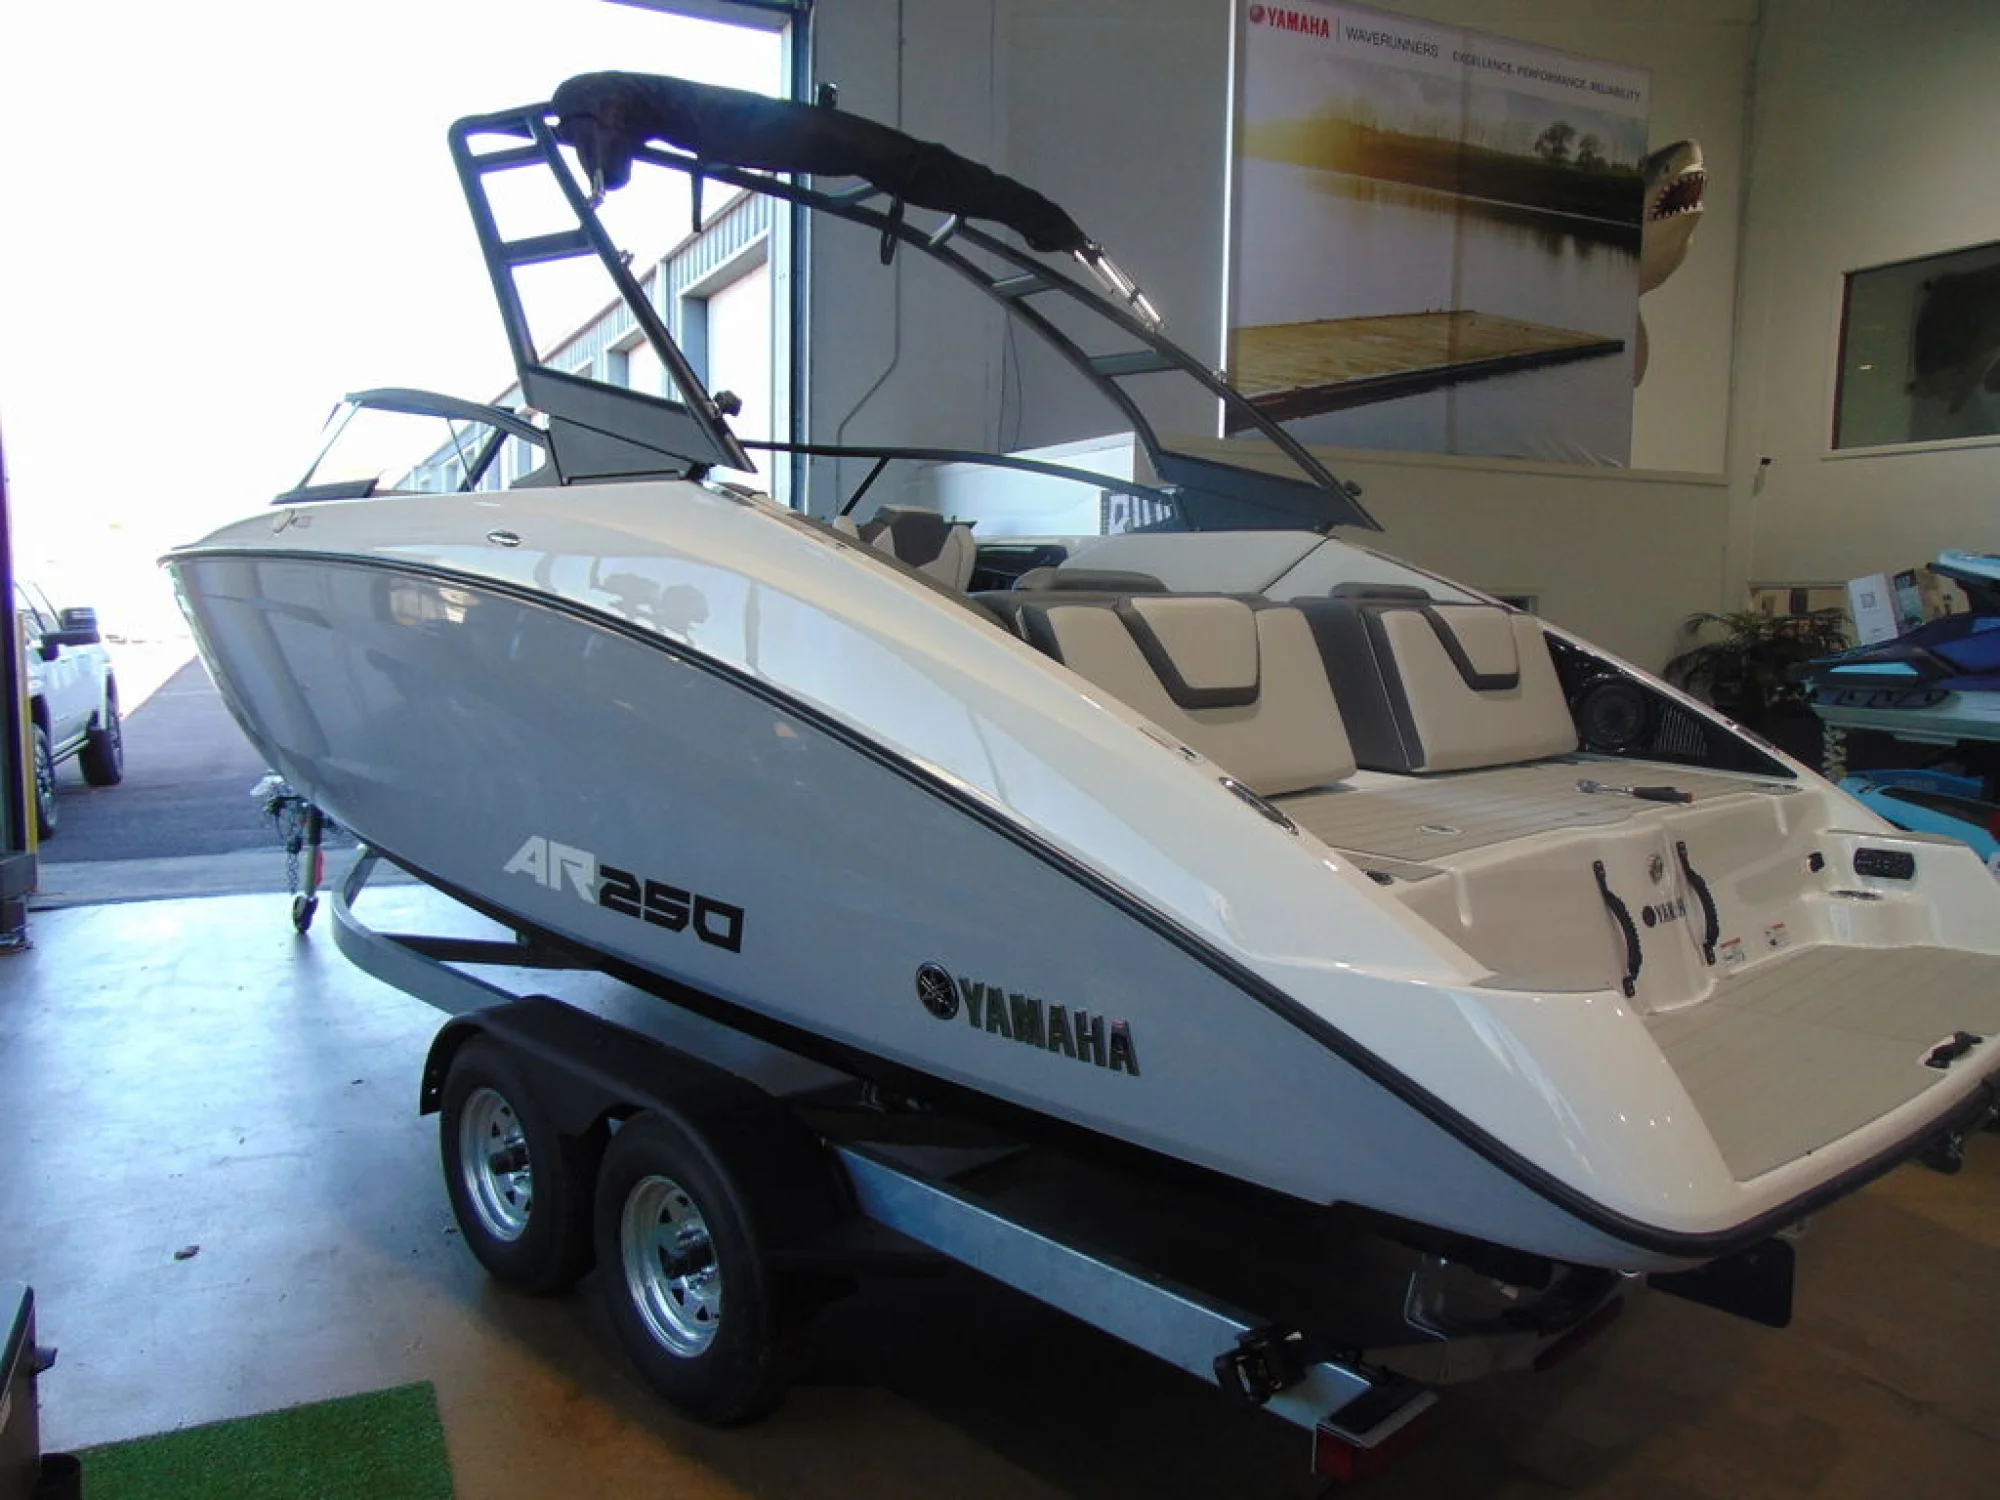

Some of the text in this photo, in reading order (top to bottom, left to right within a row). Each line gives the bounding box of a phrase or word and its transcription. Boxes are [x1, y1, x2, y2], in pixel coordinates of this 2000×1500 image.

[1266, 7, 1330, 38] YAMAHA
[1346, 26, 1439, 59] WAVERUNNERS
[958, 977, 1141, 1077] YAMAHA
